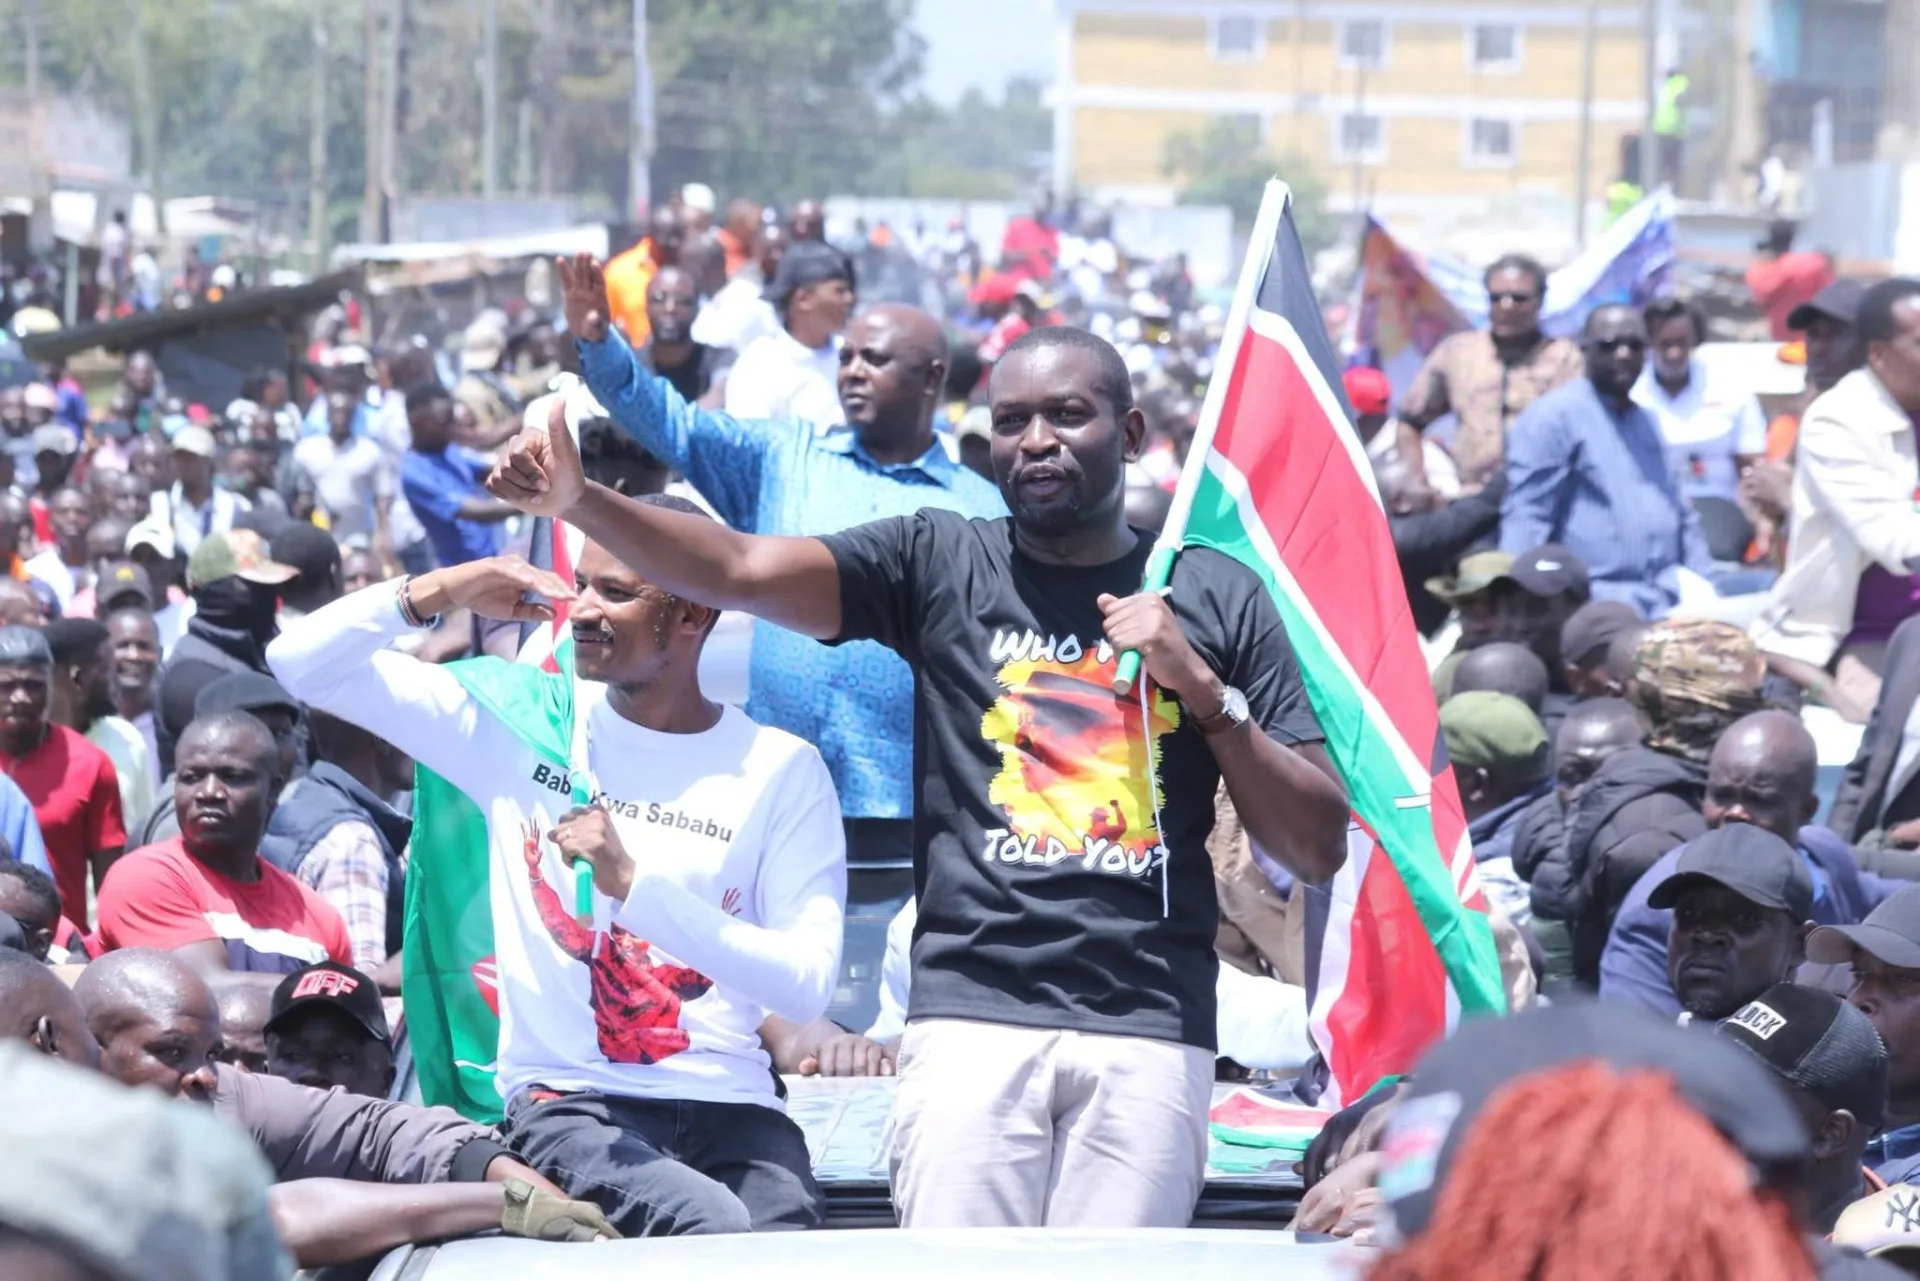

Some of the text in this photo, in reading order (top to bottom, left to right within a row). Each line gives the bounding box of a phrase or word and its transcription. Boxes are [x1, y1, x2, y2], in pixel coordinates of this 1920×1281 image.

[990, 628, 1083, 664] WHO
[532, 763, 732, 842] Bab Kwa Sababu
[982, 828, 1170, 877] TOLD YOU?
